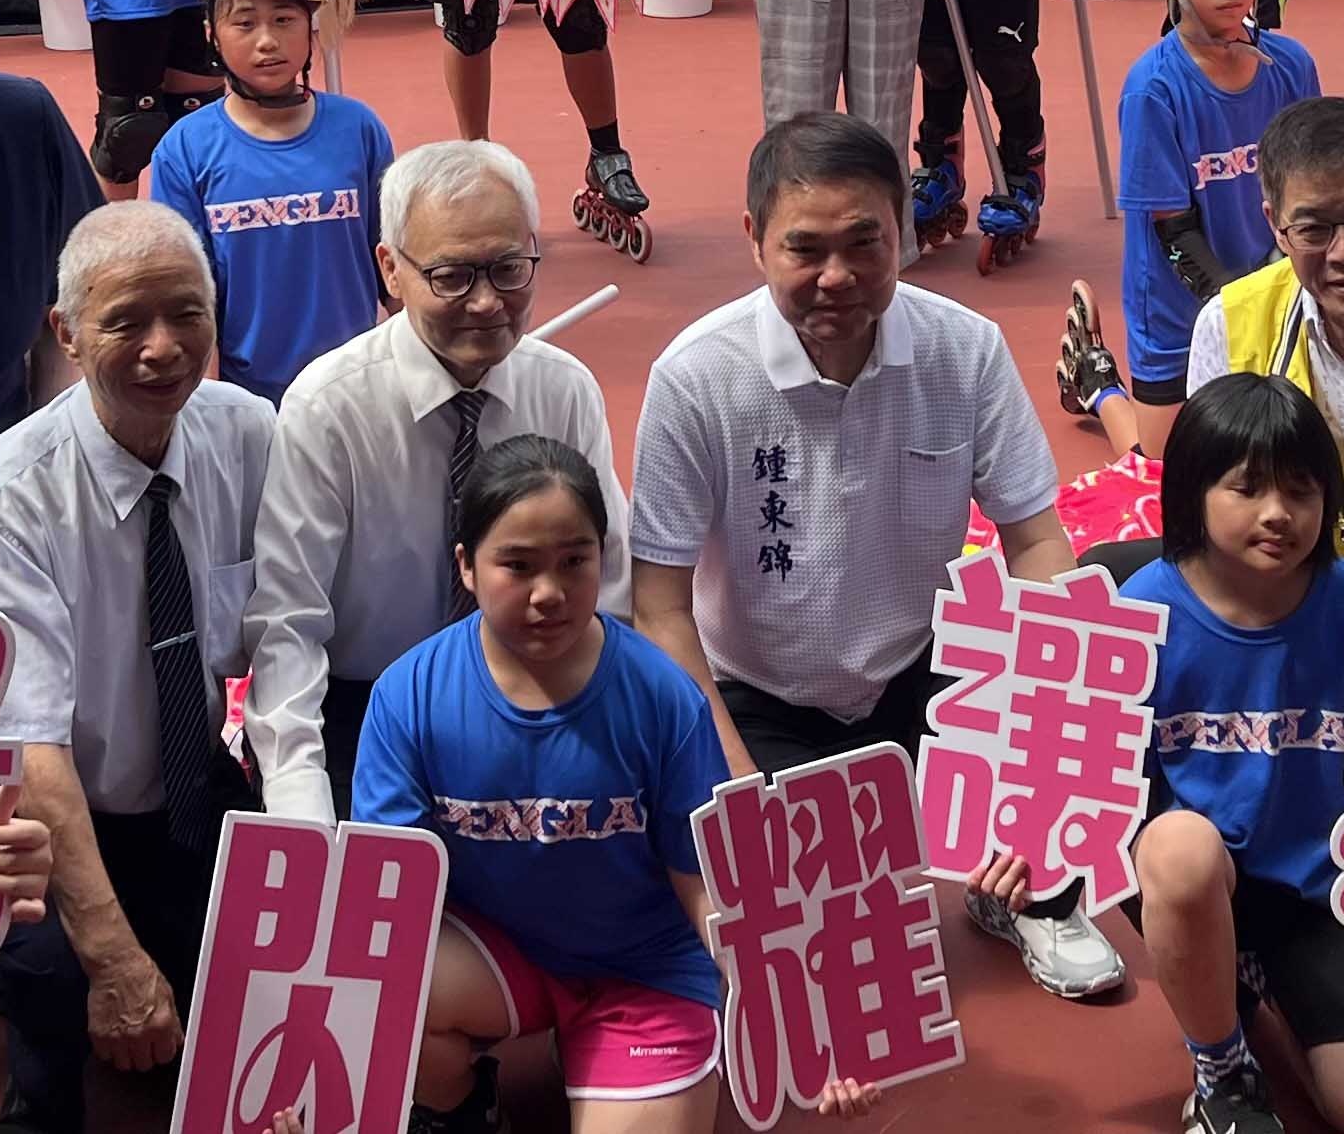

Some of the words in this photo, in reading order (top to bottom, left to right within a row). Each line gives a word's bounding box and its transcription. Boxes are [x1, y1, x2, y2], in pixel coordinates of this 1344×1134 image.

[205, 188, 361, 234] PENGLAI
[920, 556, 1164, 910] 讓
[702, 751, 959, 1122] 耀
